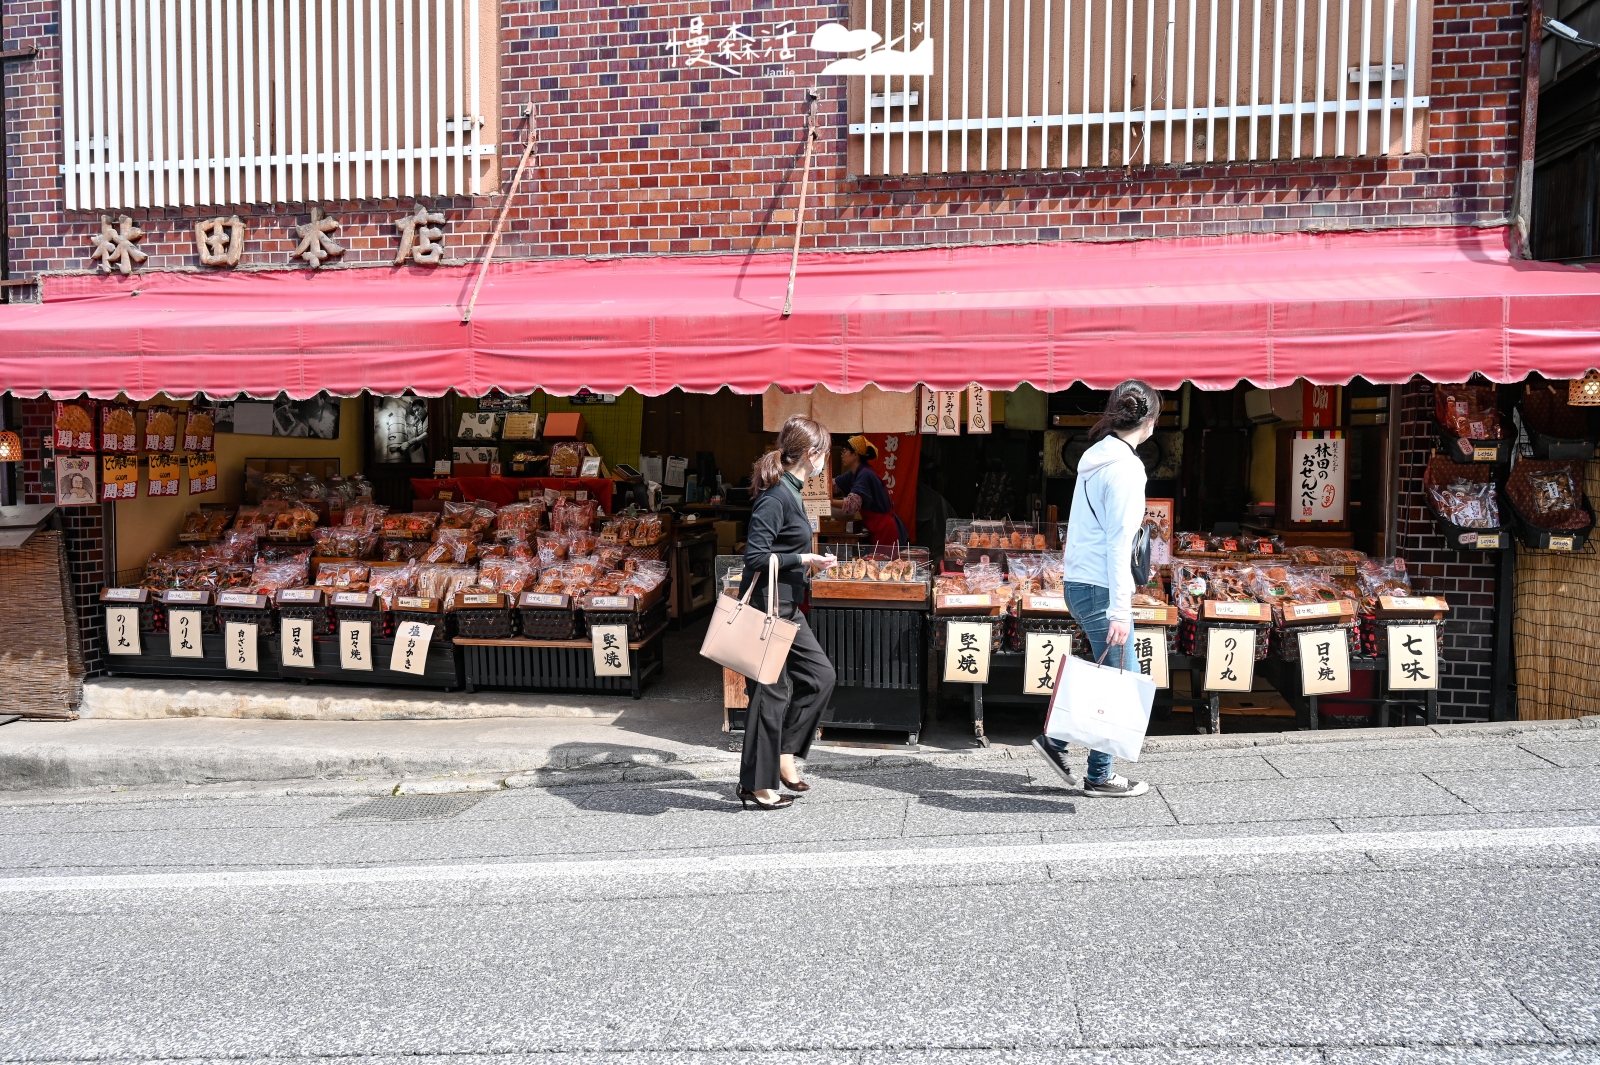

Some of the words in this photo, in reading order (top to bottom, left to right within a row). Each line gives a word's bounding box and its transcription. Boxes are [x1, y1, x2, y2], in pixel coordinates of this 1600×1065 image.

[882, 434, 899, 495] おせん
[1300, 453, 1319, 507] おせんべい
[1314, 442, 1332, 480] 林田の
[116, 614, 130, 648] のり丸
[180, 616, 193, 650] のり丸
[291, 627, 304, 658] 日々焼
[350, 630, 362, 661] 日々焼
[404, 625, 421, 670] 塩おかき
[602, 632, 622, 669] 堅焼
[956, 632, 980, 675] 堅焼
[1036, 640, 1055, 689] うす丸
[1220, 637, 1238, 682] のり丸
[1316, 641, 1336, 682] 日々焼
[1401, 634, 1431, 682] 七味
